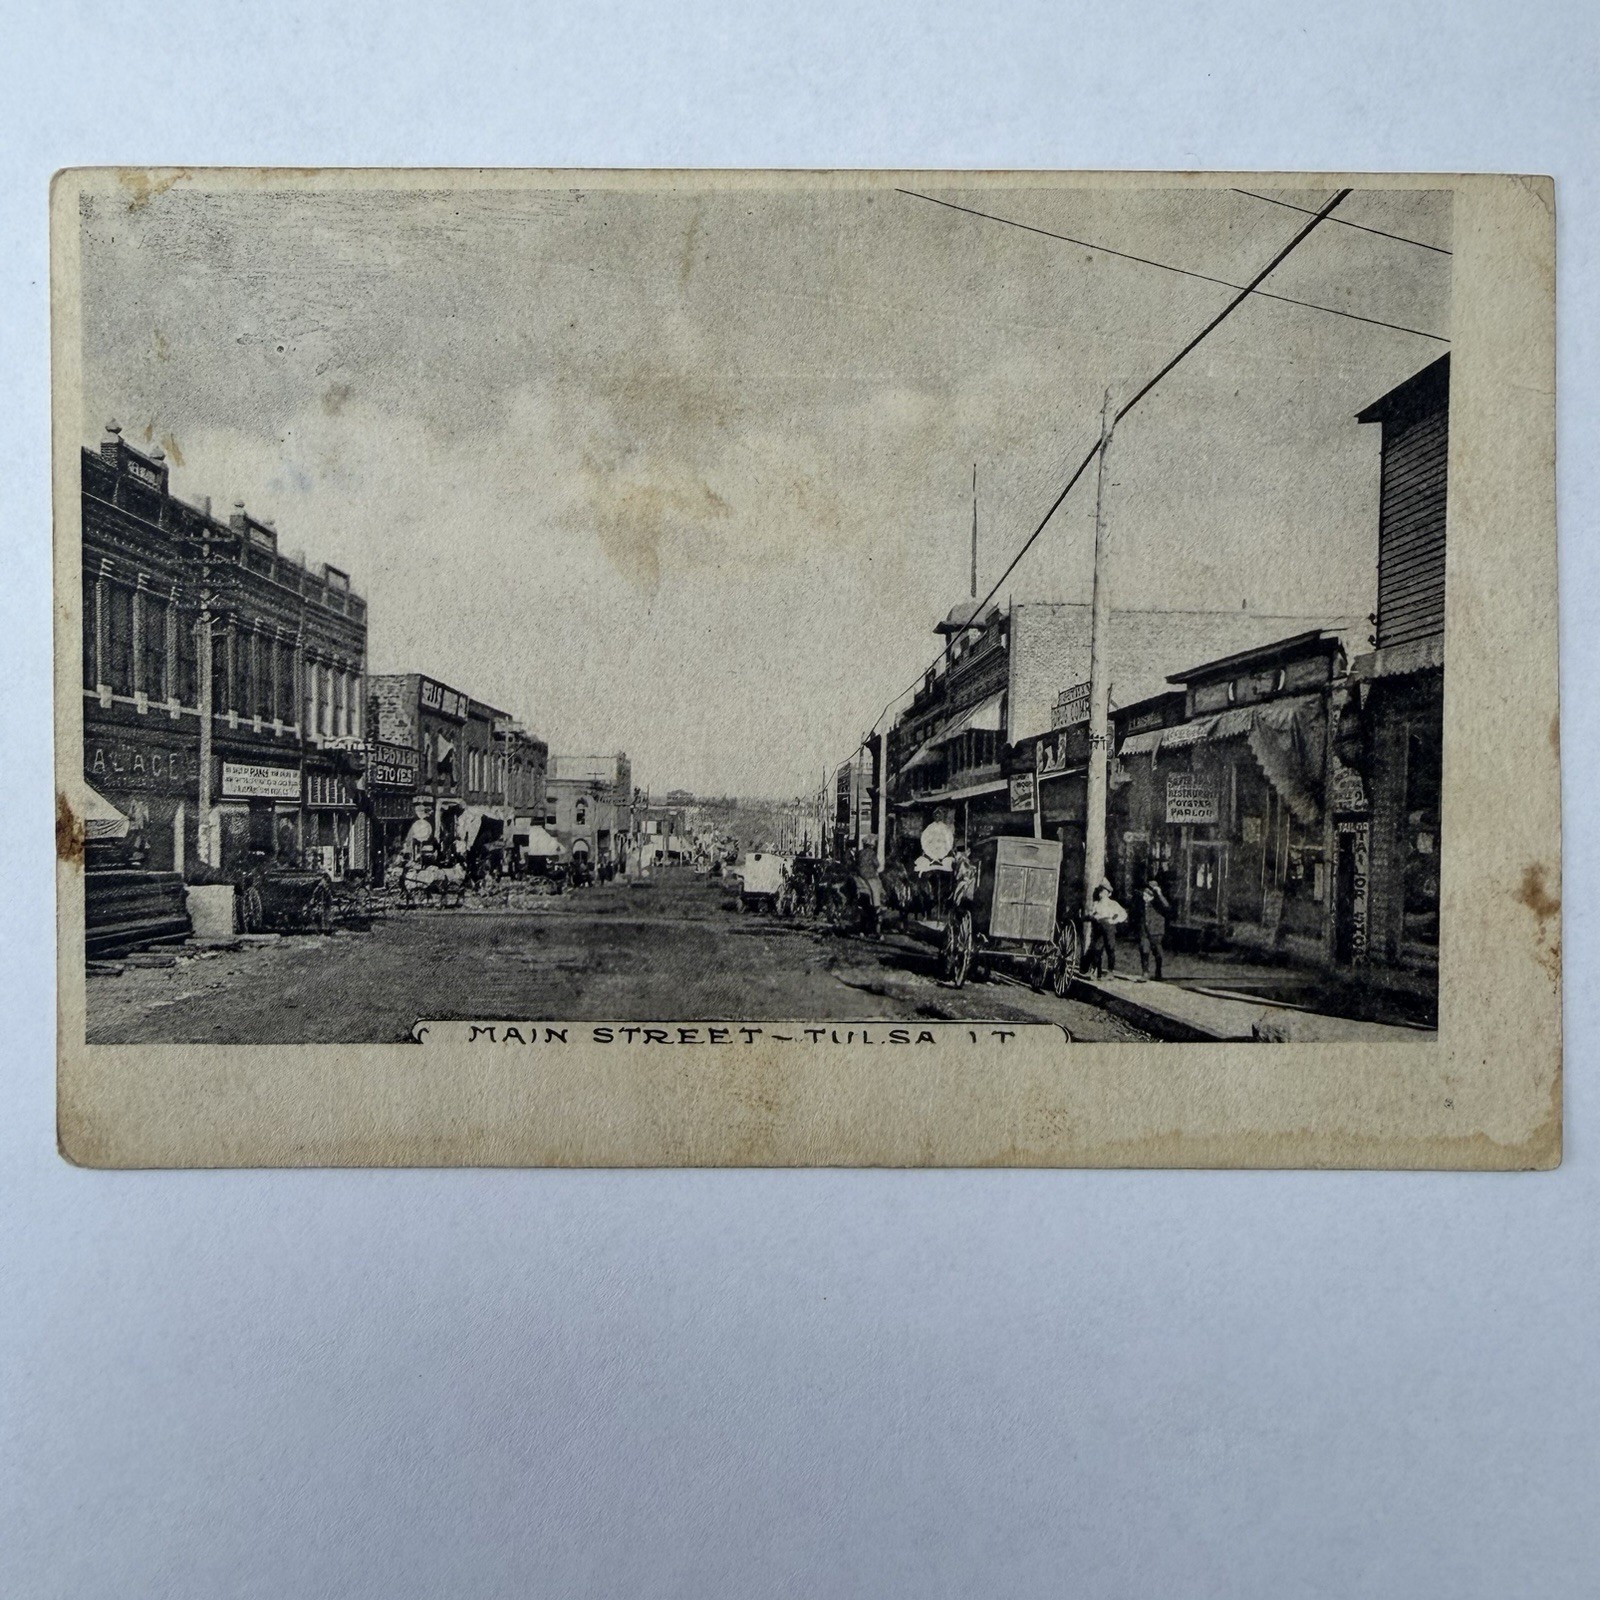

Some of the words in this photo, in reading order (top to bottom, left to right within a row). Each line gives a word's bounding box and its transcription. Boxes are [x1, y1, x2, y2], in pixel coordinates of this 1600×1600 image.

[469, 1025, 569, 1045] MAIN
[592, 1026, 763, 1045] STREET
[803, 1027, 937, 1045] TULSA
